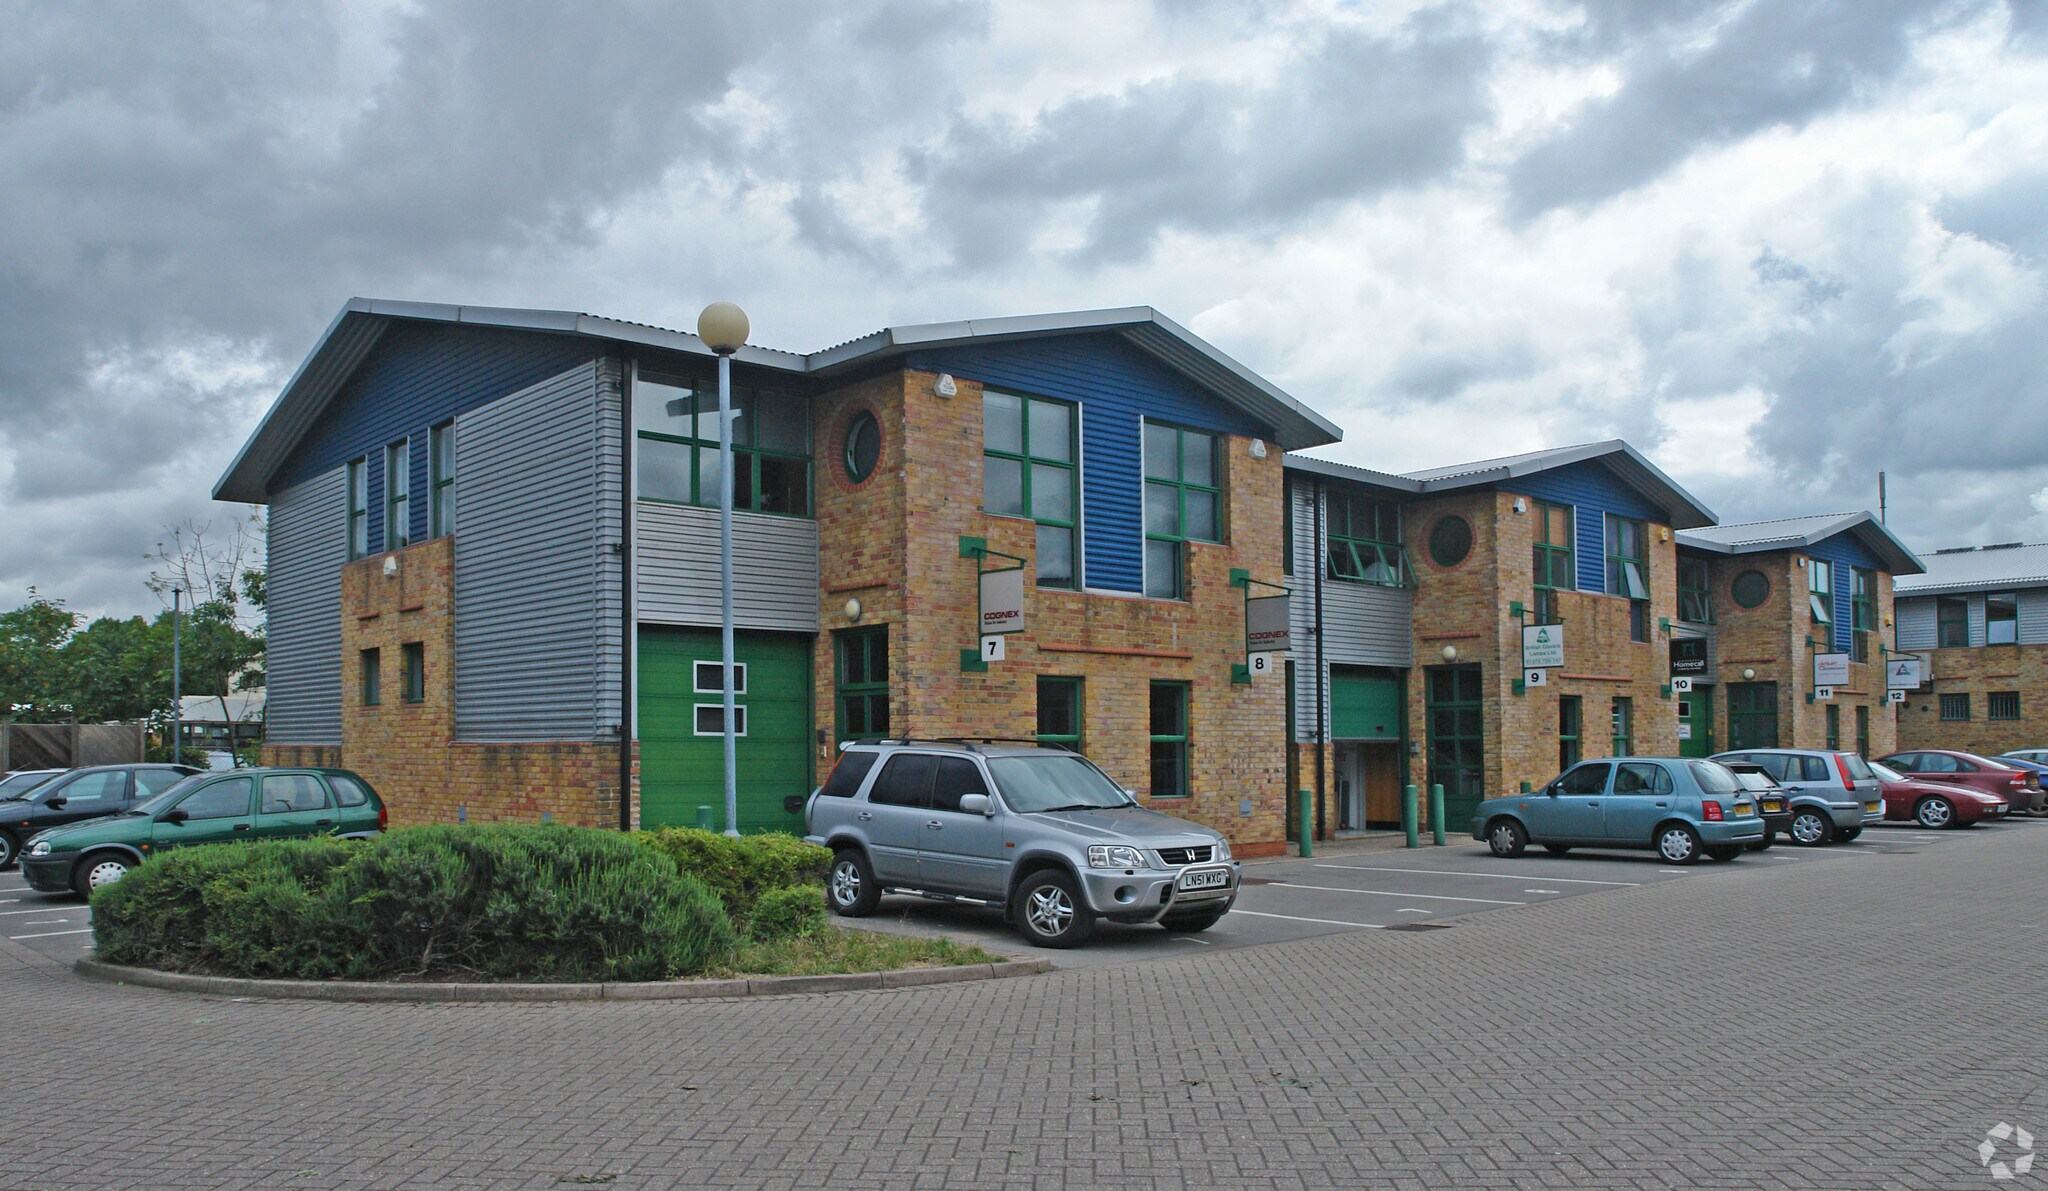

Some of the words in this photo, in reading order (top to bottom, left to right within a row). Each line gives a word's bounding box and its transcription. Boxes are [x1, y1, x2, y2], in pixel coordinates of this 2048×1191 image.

[984, 610, 1019, 620] COGNEX
[1248, 630, 1289, 640] COGNEX
[988, 641, 996, 656] 7
[1255, 657, 1264, 670] 8
[1673, 660, 1704, 668] Homecall
[1531, 672, 1539, 683] 9
[1674, 680, 1688, 689] 10
[1891, 692, 1902, 700] 12
[1185, 874, 1205, 887] LN51
[1206, 872, 1222, 885] WXG
